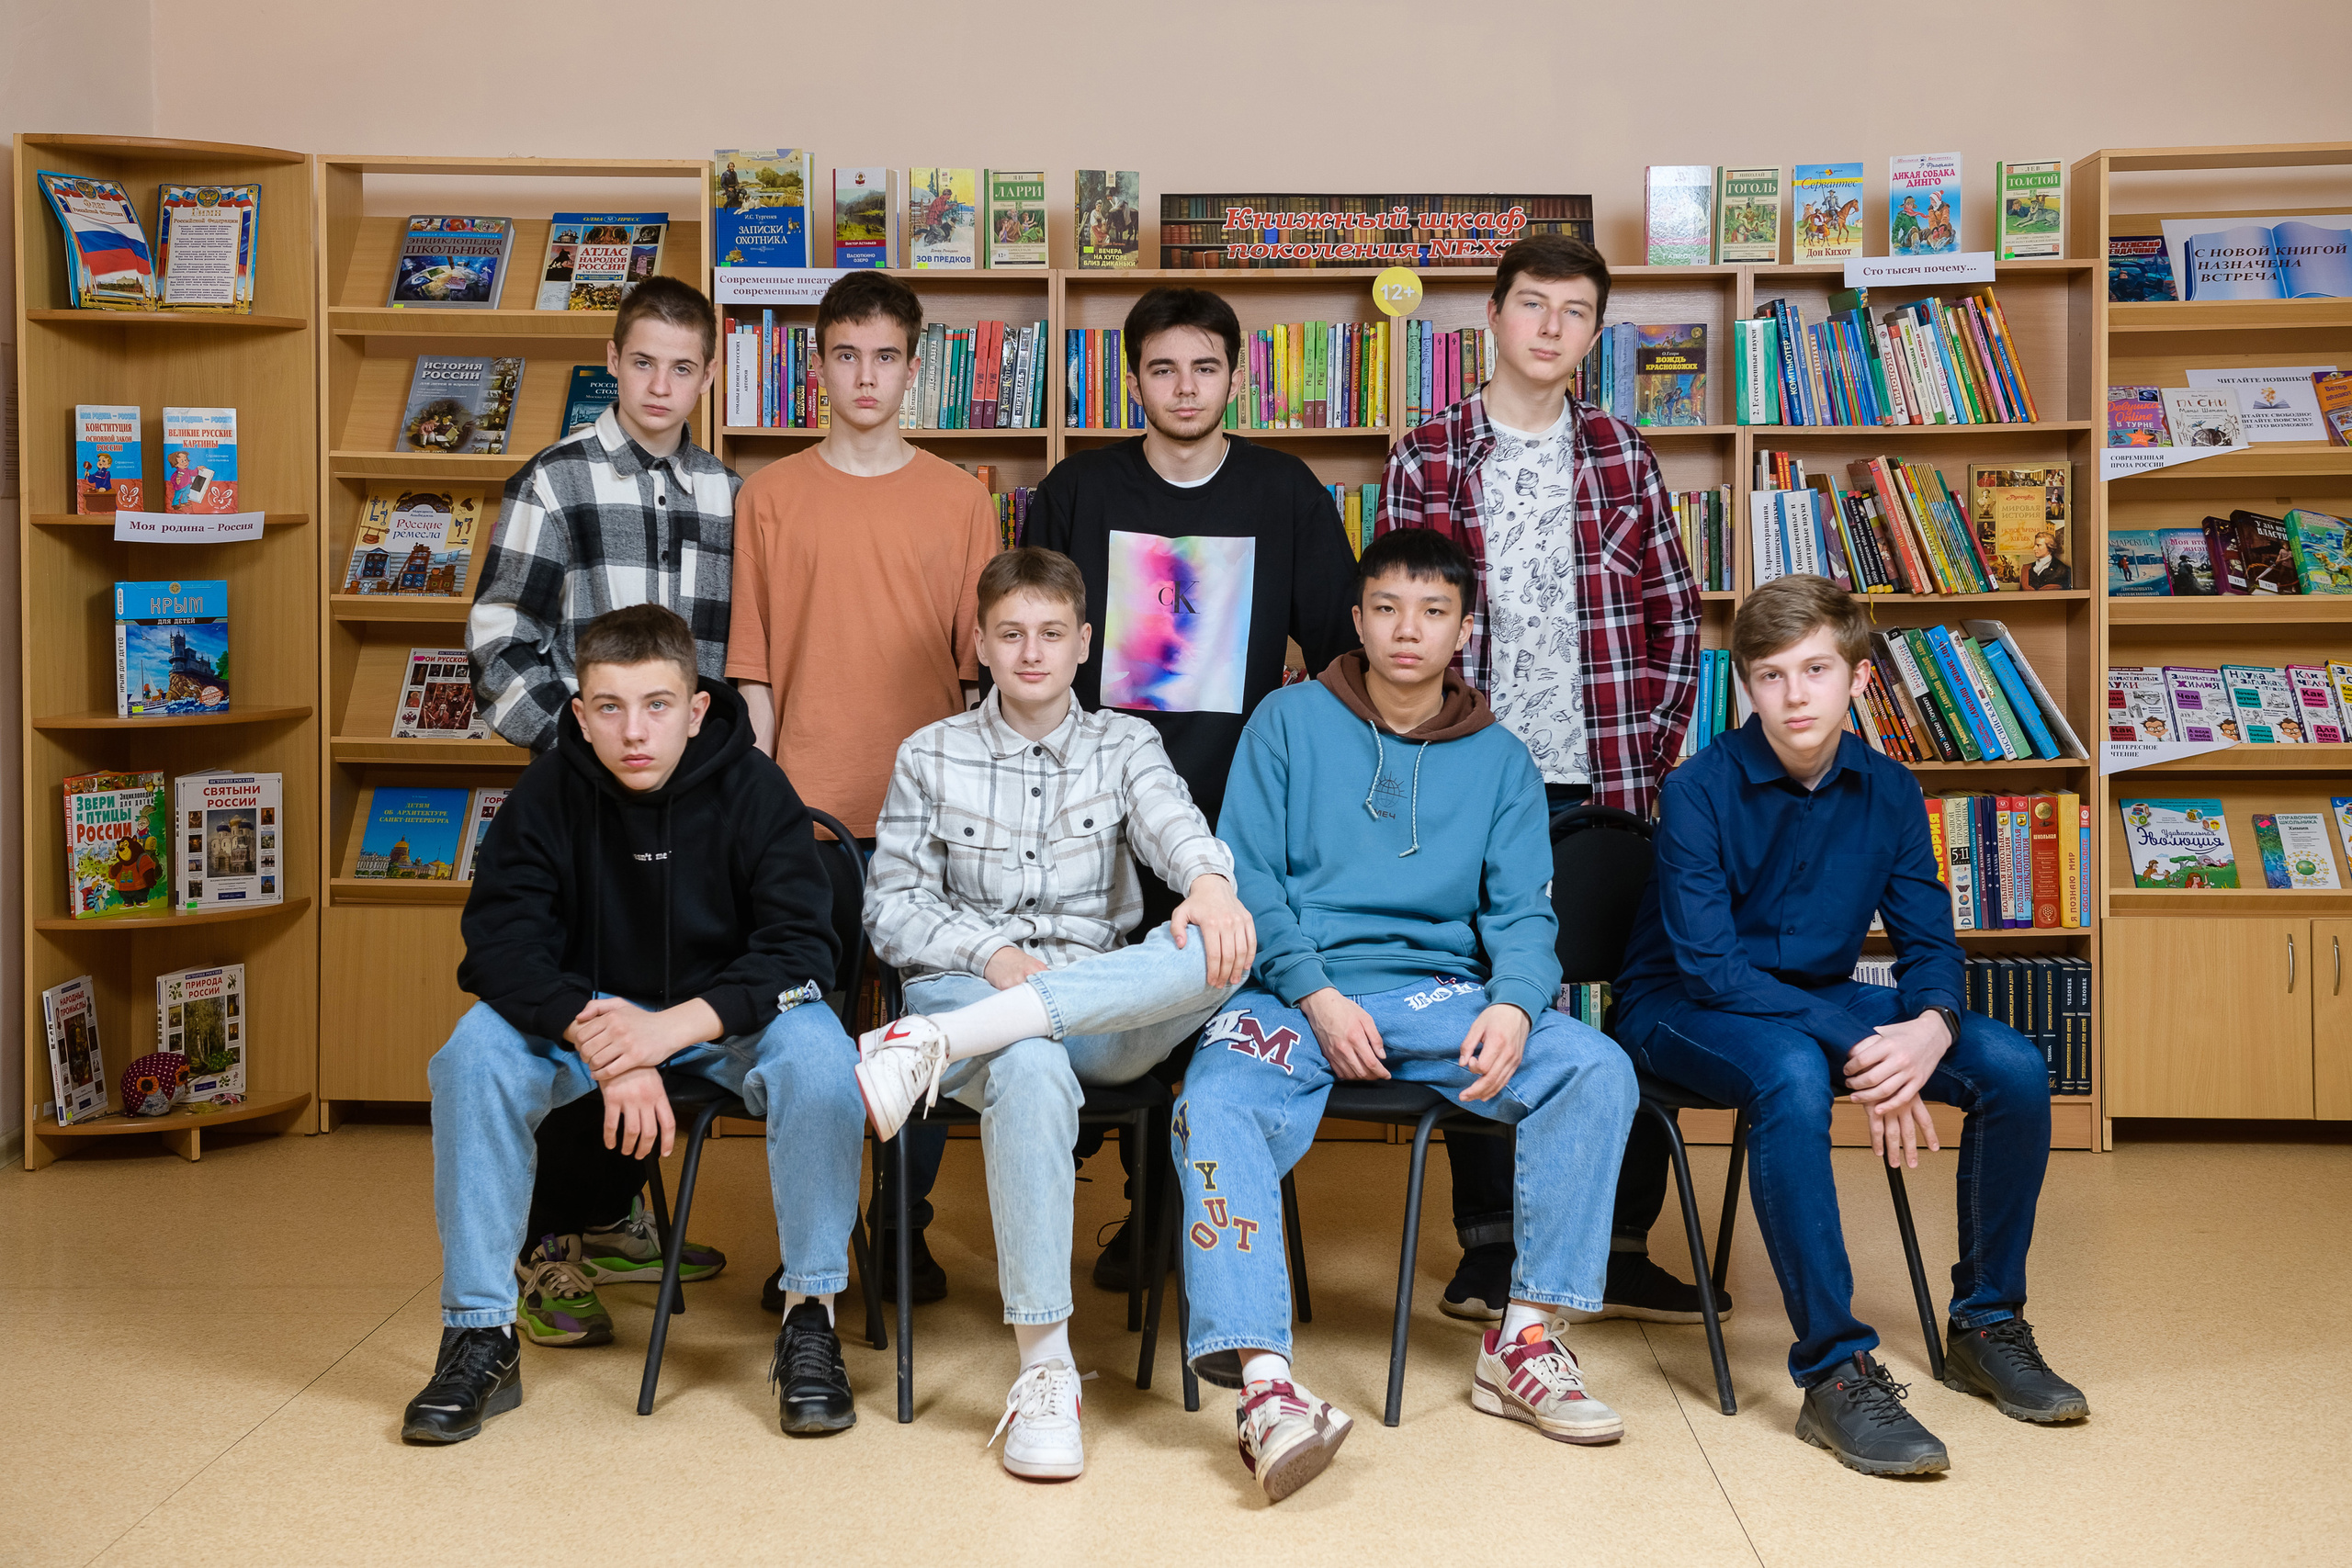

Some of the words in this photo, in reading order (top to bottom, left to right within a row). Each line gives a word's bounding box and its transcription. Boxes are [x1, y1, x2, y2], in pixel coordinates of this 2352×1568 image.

[1893, 172, 1921, 181] ДИКАЯ
[1922, 169, 1955, 178] СОБАКА
[2008, 174, 2058, 186] ТОЛСТОЙ
[1727, 183, 1777, 194] ГОГОЛЬ
[1801, 177, 1859, 192] Сервантес
[1906, 178, 1941, 188] ДИНГО
[995, 186, 1043, 197] ЛАРРИ
[83, 199, 107, 209] Флаг
[192, 208, 221, 216] Гимн
[1223, 207, 1410, 231] Книжный
[1418, 206, 1527, 236] шкаф
[739, 225, 784, 234] ЗАПИСКИ
[408, 238, 503, 246] ЭНЦИКЛОПЕДИЯ
[735, 235, 787, 244] ОХОТНИКА
[404, 245, 501, 255] ШКОЛЬНИКА
[581, 248, 628, 257] АТЛАС
[1227, 241, 1420, 260] поколения
[1806, 248, 1823, 257] Дон
[1826, 247, 1851, 256] Кихот
[2195, 249, 2205, 257] С
[2210, 245, 2269, 257] НОВОЙ
[2274, 243, 2347, 255] КНИГОЙ
[579, 256, 627, 265] НАРОДОВ
[916, 254, 933, 263] ЗОВ
[578, 263, 626, 271] РОССИИ
[1863, 267, 1883, 276] Сто
[1885, 266, 1921, 276] тысяч
[1924, 264, 1977, 274] почему...
[2198, 259, 2302, 270] НАЗНАЧЕНА
[719, 275, 794, 285] Современные
[2200, 273, 2278, 282] ВСТРЕЧА
[733, 288, 808, 296] современным
[1380, 284, 1415, 301] 12+
[424, 362, 482, 370] ИСТОРИЯ
[1782, 340, 1798, 395] КОМПЬЮТЕР
[422, 371, 481, 380] РОССИИ
[1885, 352, 1903, 405] ЭКОЛОГИЯ
[2108, 401, 2159, 412] Девушка
[2114, 412, 2153, 423] Online
[85, 423, 132, 433] КОНСТИТУЦИЯ
[168, 429, 200, 437] ВЕЛИКИЕ
[202, 430, 232, 438] РУССКИЕ
[183, 440, 218, 448] КАРТИНЫ
[130, 521, 155, 531] Моя
[162, 524, 204, 533] родина
[218, 522, 254, 532] Россия
[396, 519, 443, 531] Русские
[392, 530, 440, 539] ремесла
[1763, 503, 1772, 572] Здравоохранения.
[1791, 513, 1803, 570] Общественные
[151, 597, 203, 614] КРЫМ
[1939, 641, 1951, 658] ЧТО?
[1947, 660, 1963, 686] ЗАЧЕМ?
[1960, 687, 1979, 718] ПОЧЕМУ?
[2230, 671, 2266, 680] НАУКА
[2176, 681, 2221, 689] ХИМИЯ
[1916, 640, 1926, 655] ЧТО?
[1922, 656, 1938, 680] ЗАЧЕМ?
[1934, 681, 1951, 708] ПОЧЕМУ?
[1949, 712, 1969, 744] ДИНОЗАВРЫ
[2177, 693, 2199, 701] Чем
[1984, 701, 2014, 755] РОССИЙСКАЯ
[1998, 704, 2021, 741] ЭКОЛОГИЯ
[203, 785, 261, 796] СВЯТЫНИ
[77, 795, 115, 811] ЗВЕРИ
[208, 797, 256, 807] РОССИИ
[86, 808, 131, 824] ПТИЦЫ
[379, 816, 449, 824] САНКТ-ПЕТЕРБУРГА
[77, 822, 131, 843] РОССИИ
[2136, 827, 2224, 848] Эволюция
[2162, 829, 2216, 837] Удивительная
[1998, 828, 2007, 874] ШКОЛЬНАЯ
[2006, 837, 2014, 901] ЭНЦИКЛОПЕДИЯ
[2023, 838, 2031, 902] ЭНЦИКЛОПЕДИЯ
[2083, 863, 2088, 872] НА
[186, 977, 222, 989] ПРИРОДА
[188, 987, 220, 998] РОССИИ
[60, 991, 85, 1006] НАРОДНЫЕ
